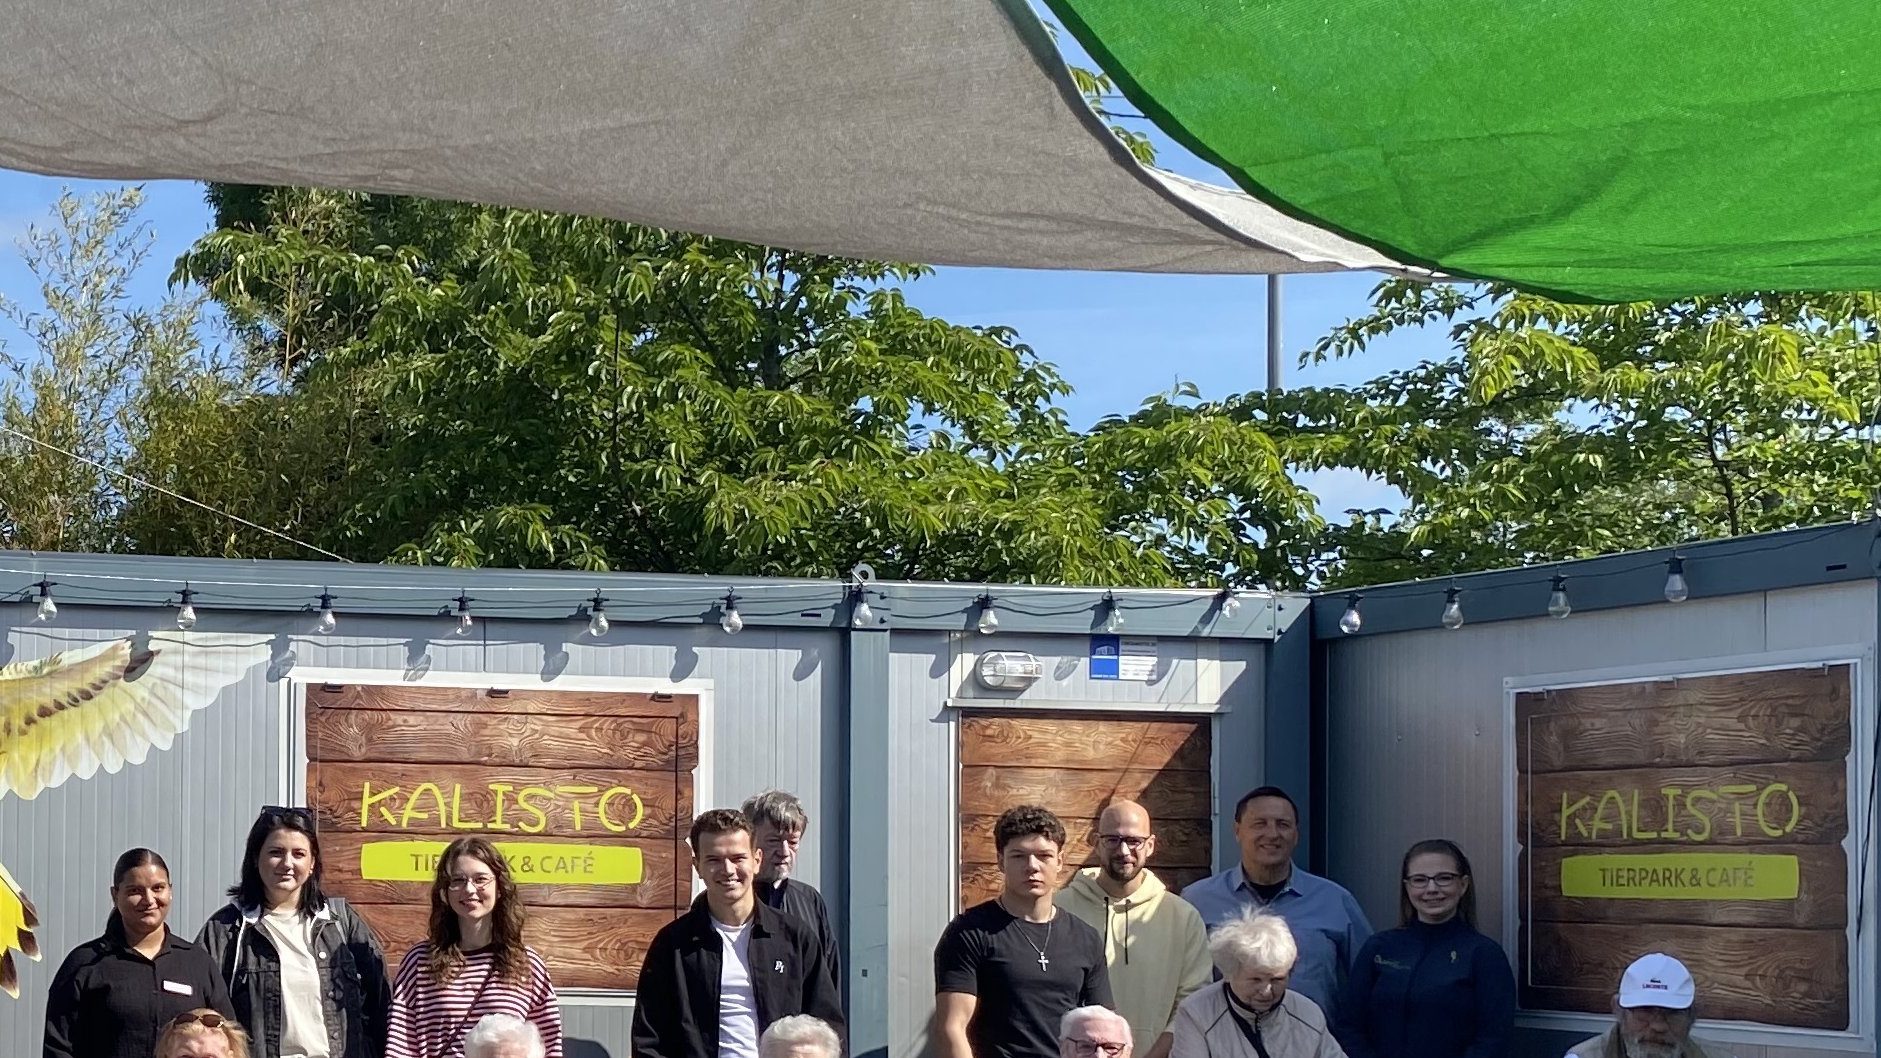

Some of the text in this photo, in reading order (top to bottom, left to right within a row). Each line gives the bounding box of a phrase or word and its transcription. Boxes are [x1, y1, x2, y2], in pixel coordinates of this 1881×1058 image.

[361, 782, 644, 833] KALISTO
[1560, 783, 1800, 842] KALISTO
[410, 851, 595, 874] TIEK & CAFÉ
[1598, 860, 1755, 888] TIERPARK & CAFÉ
